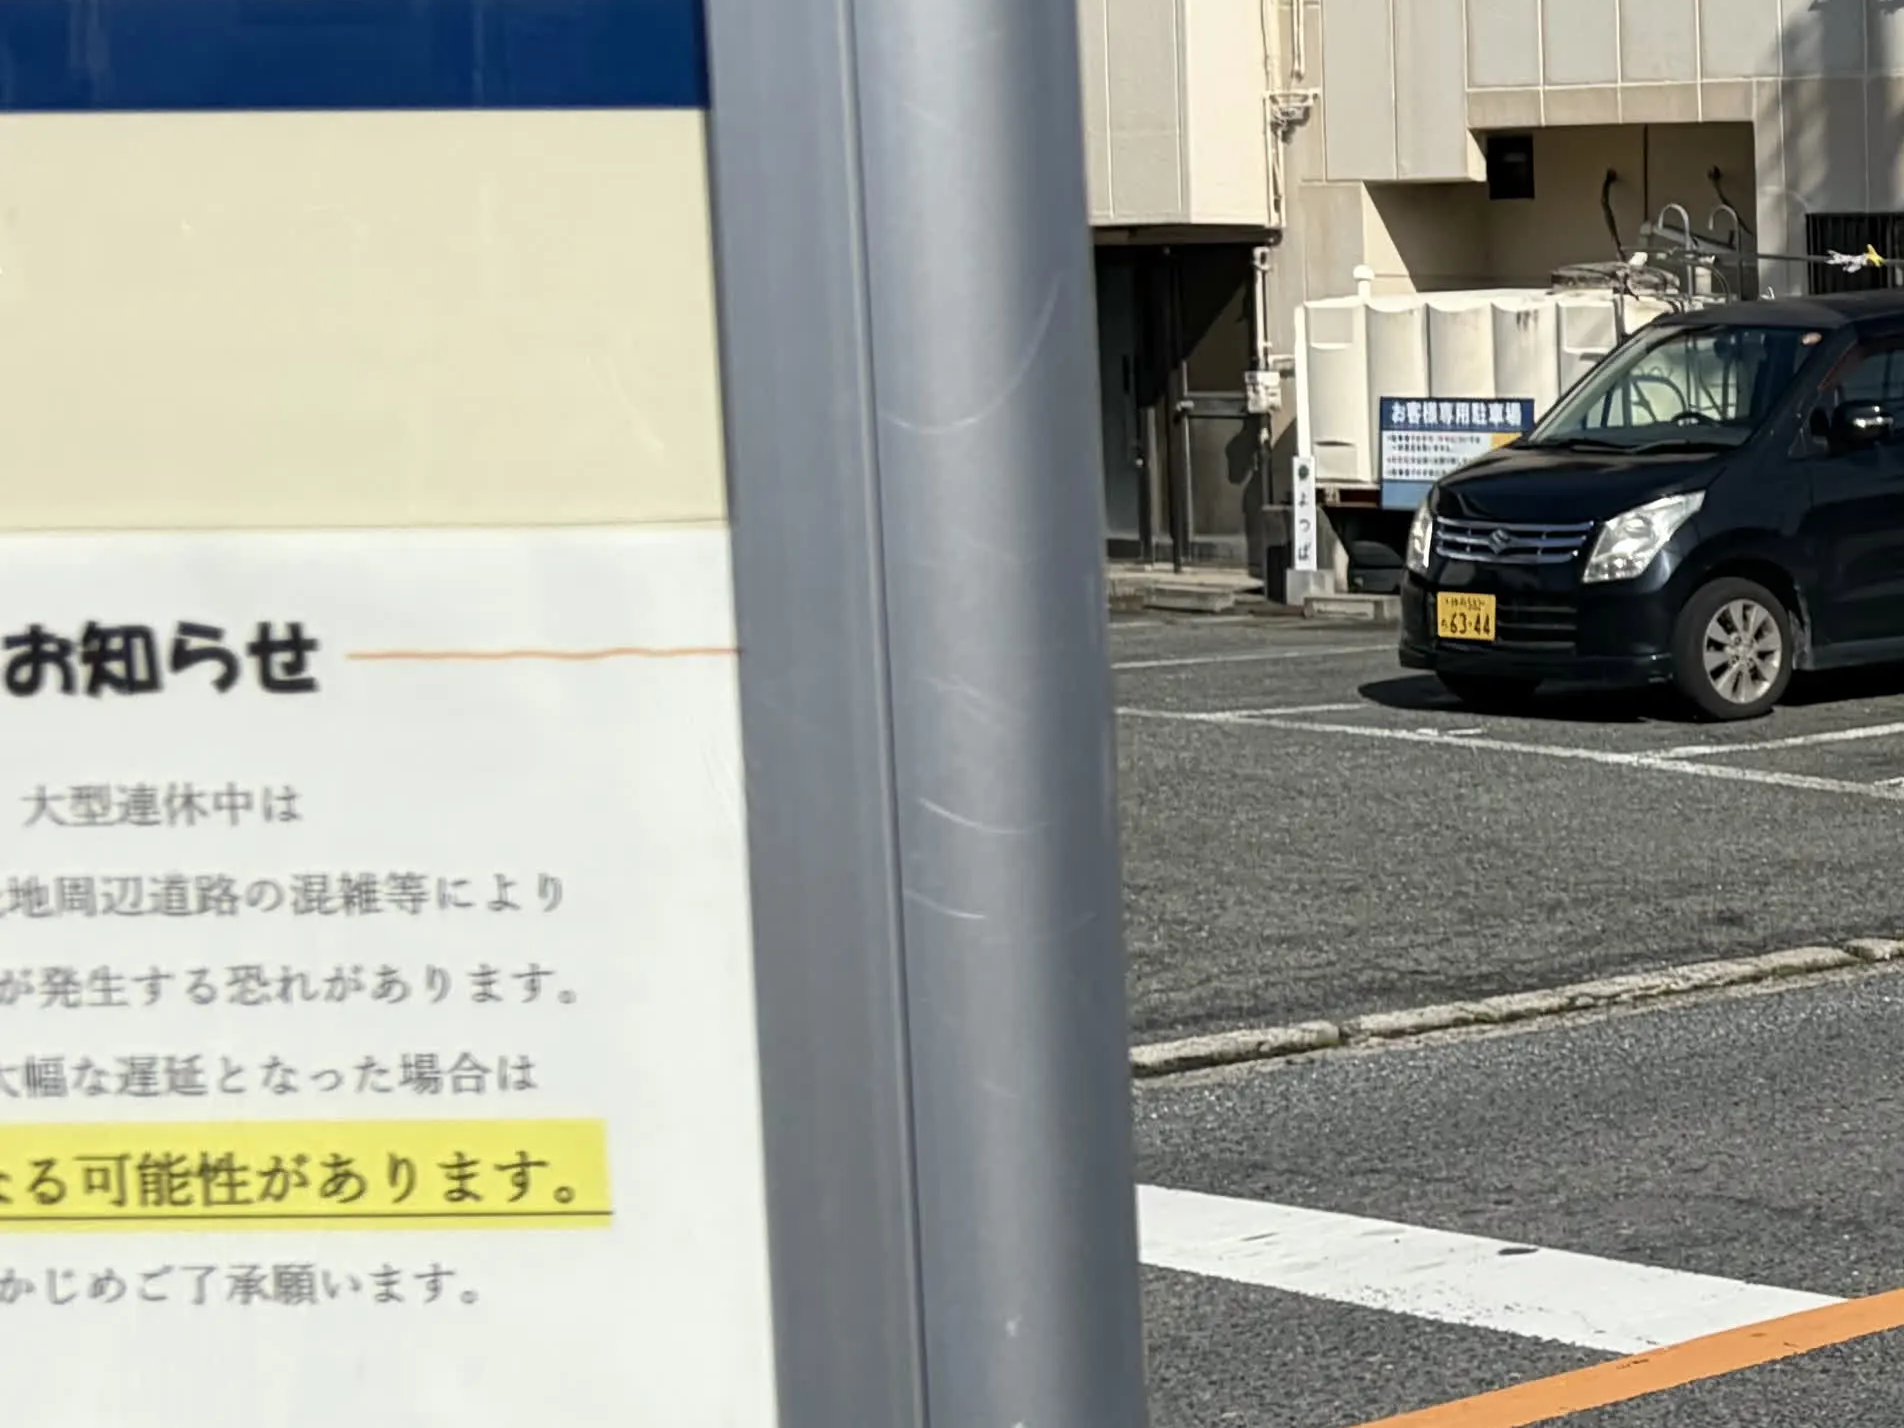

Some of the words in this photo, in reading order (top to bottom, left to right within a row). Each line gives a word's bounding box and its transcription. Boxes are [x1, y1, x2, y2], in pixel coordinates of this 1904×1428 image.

[1391, 401, 1522, 428] お客様専用駐車場
[1, 620, 321, 698] お知らせ
[18, 782, 304, 827] 大型連休中は
[0, 870, 564, 918] 地周辺道路の混雑等により
